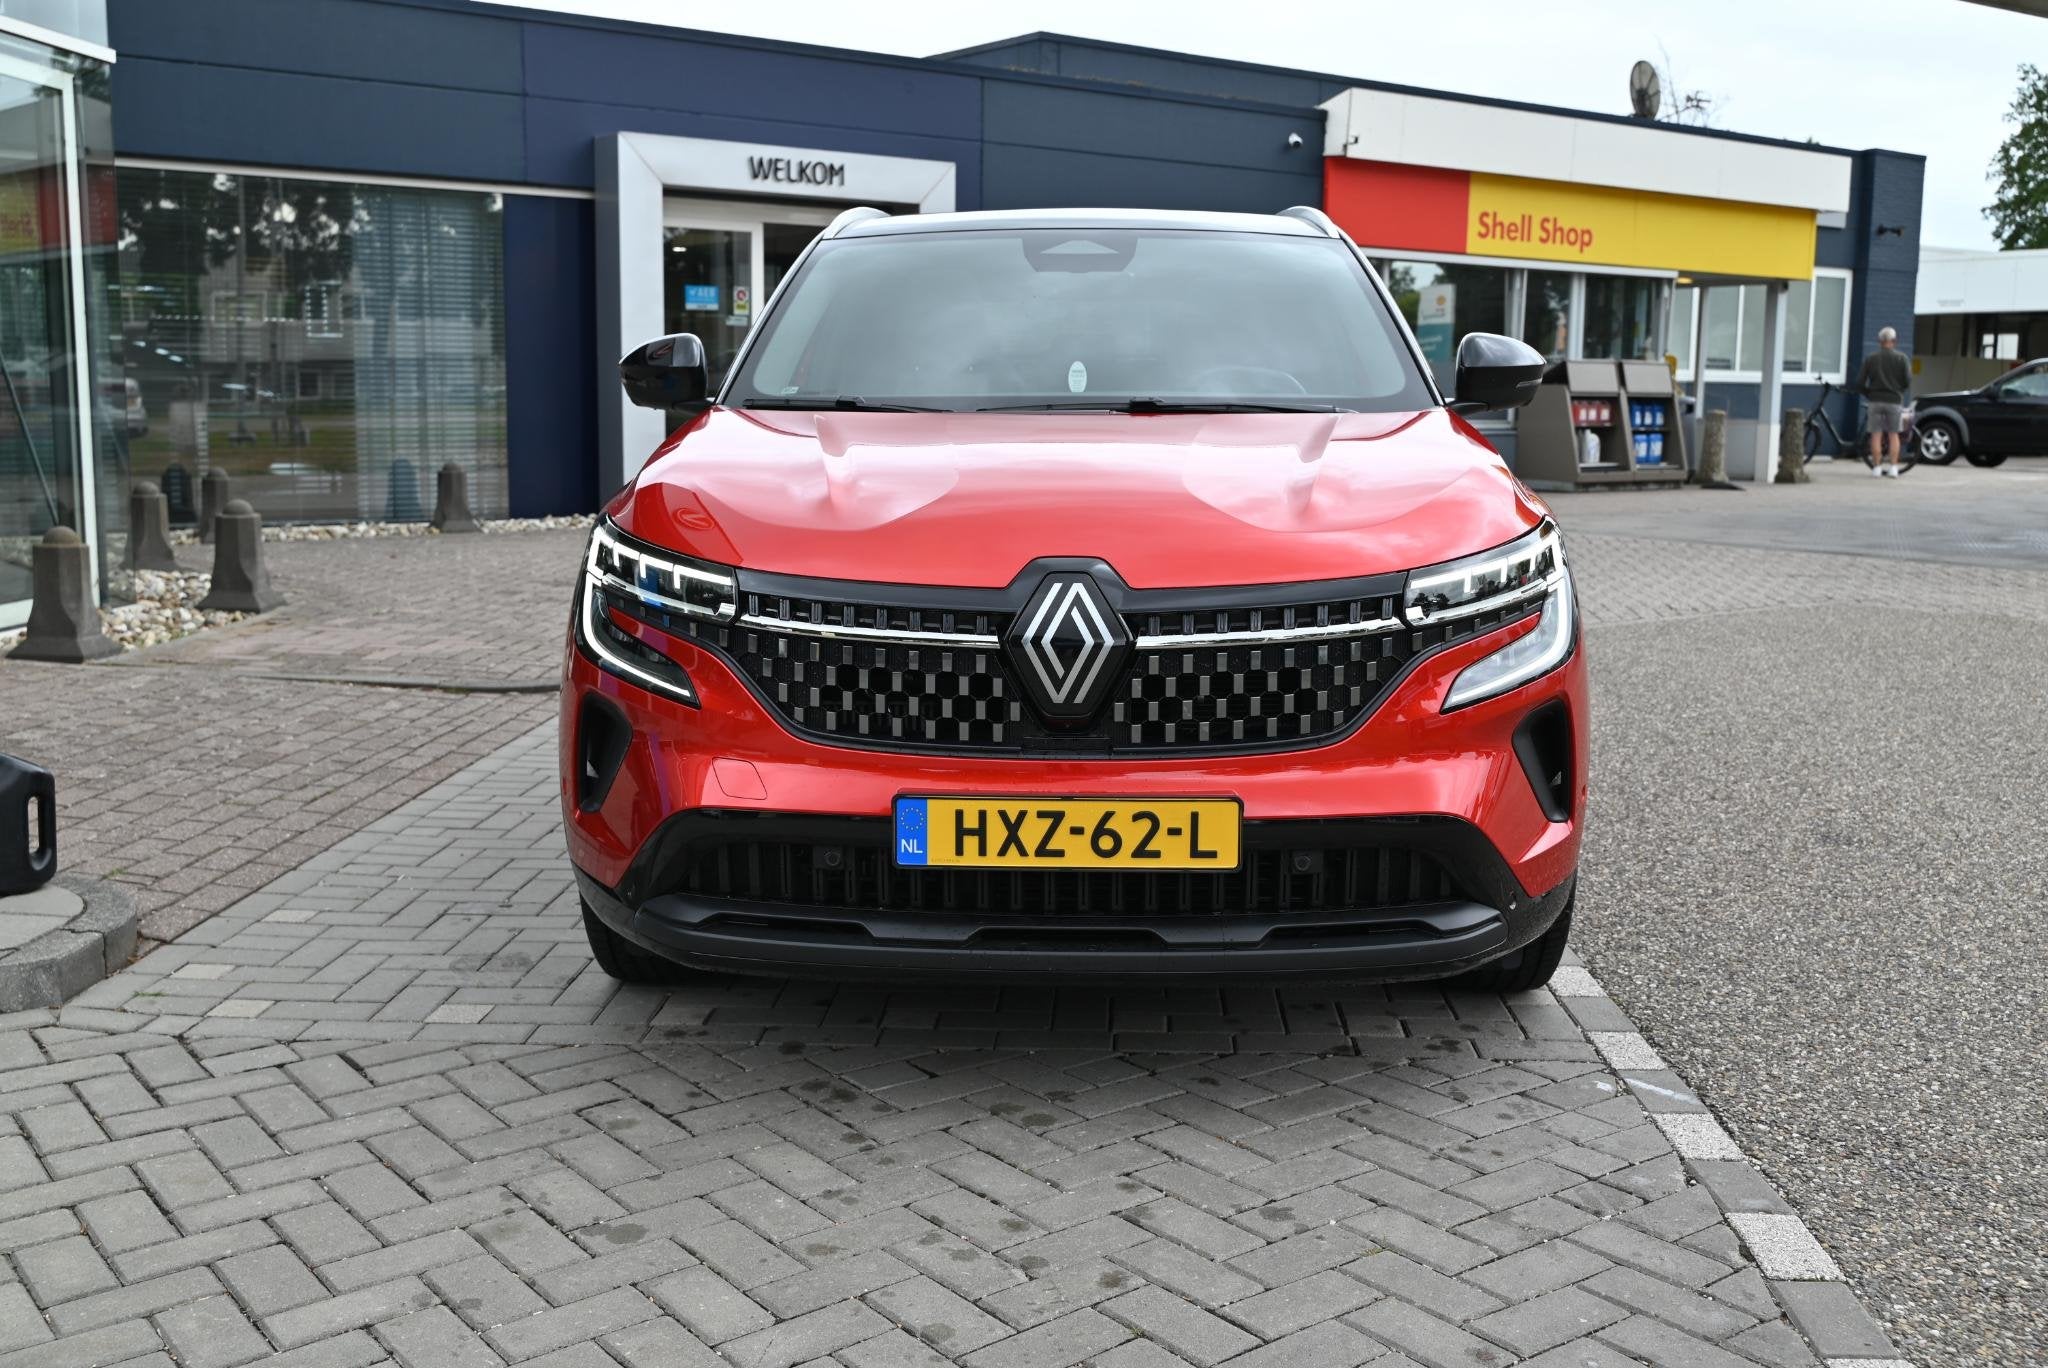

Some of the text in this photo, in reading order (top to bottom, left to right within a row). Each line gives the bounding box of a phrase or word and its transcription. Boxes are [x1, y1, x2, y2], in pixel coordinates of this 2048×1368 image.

[748, 156, 845, 186] WELKOM
[1478, 211, 1593, 254] Shell Shop
[901, 838, 923, 854] NL
[954, 809, 1218, 859] HXZ-62-L
